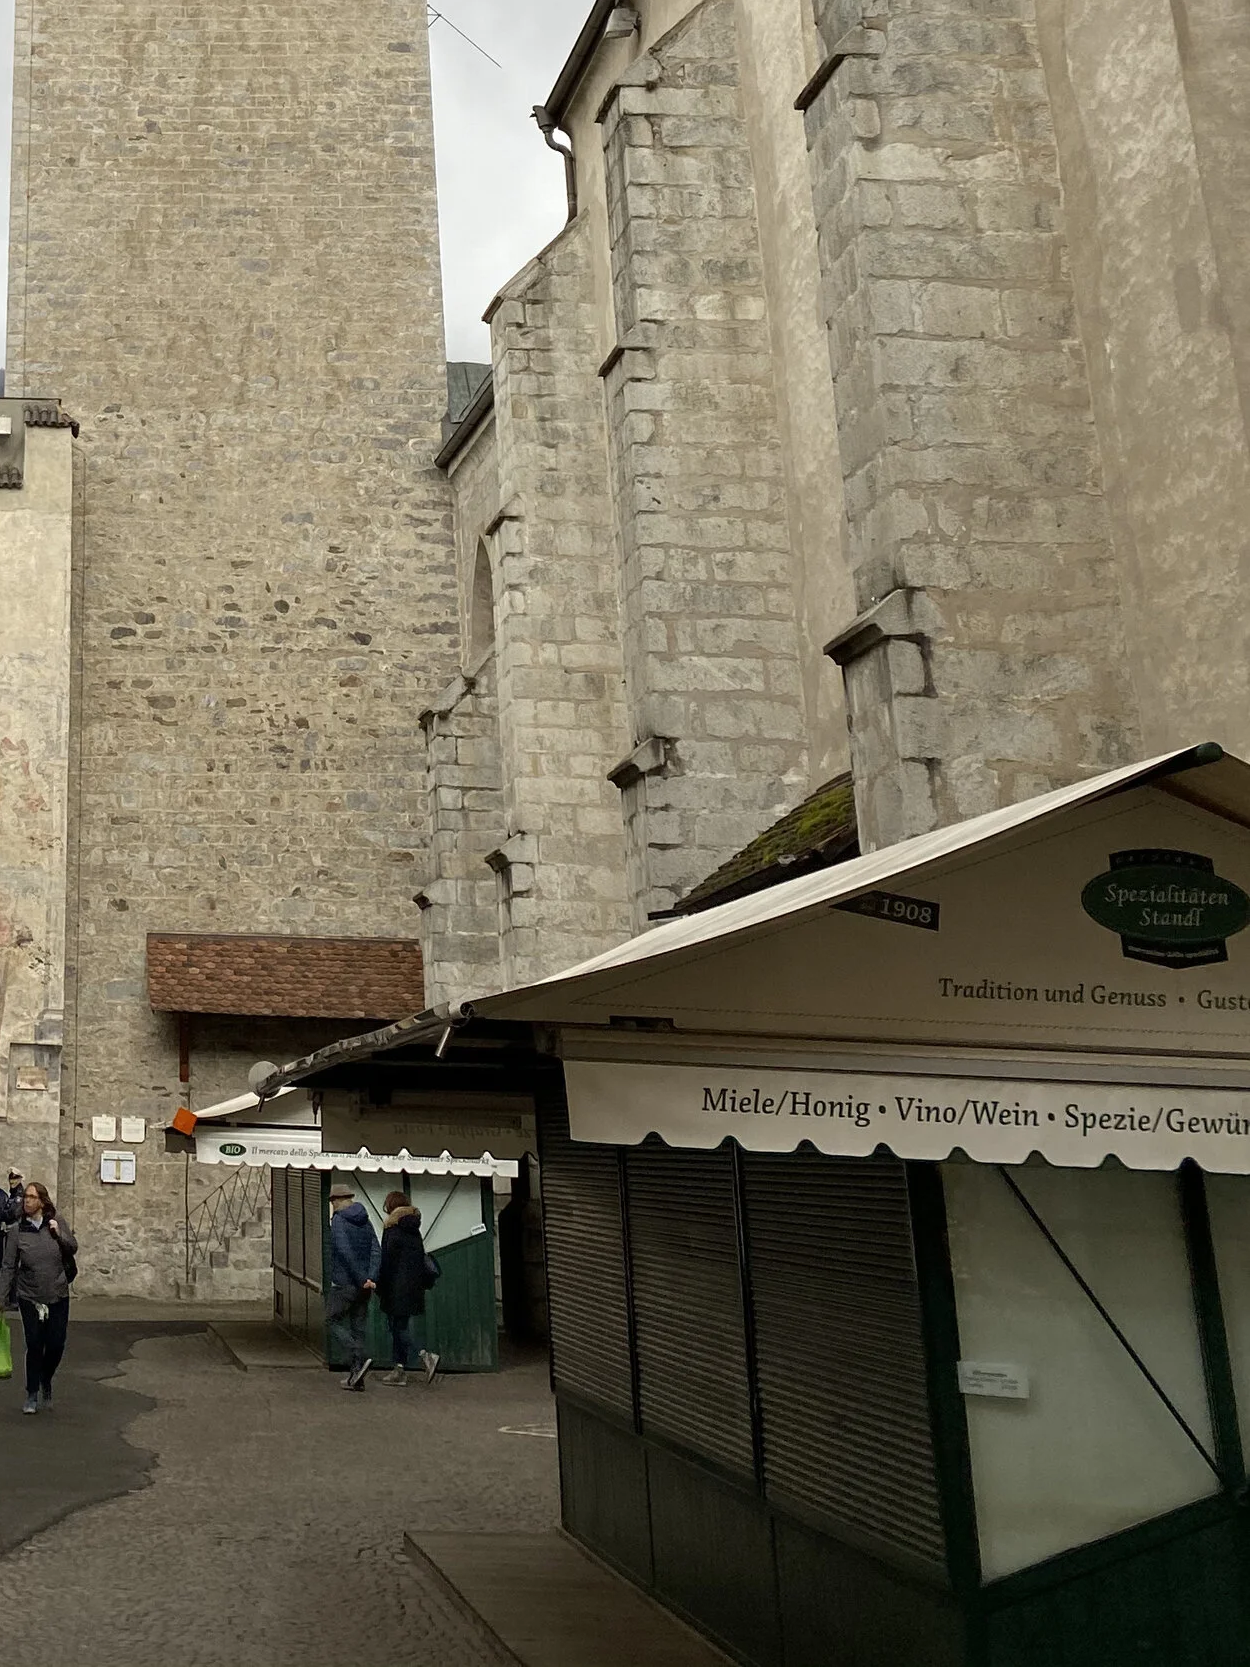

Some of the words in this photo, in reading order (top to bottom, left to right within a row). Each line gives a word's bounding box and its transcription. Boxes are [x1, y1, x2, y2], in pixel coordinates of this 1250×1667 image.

[1104, 883, 1231, 908] Spezialitäten
[880, 898, 933, 924] 1908
[1139, 907, 1205, 928] Standl
[938, 977, 1038, 1003] Tradition
[1045, 983, 1085, 1005] und
[1091, 984, 1167, 1008] Genuss
[1197, 989, 1250, 1011] Gust
[701, 1087, 871, 1128] Miele/Honig
[895, 1095, 1040, 1127] Vino/Wein
[225, 1145, 241, 1155] BIO
[251, 1147, 258, 1155] Il
[259, 1148, 289, 1156] mercato
[290, 1147, 308, 1157] dello
